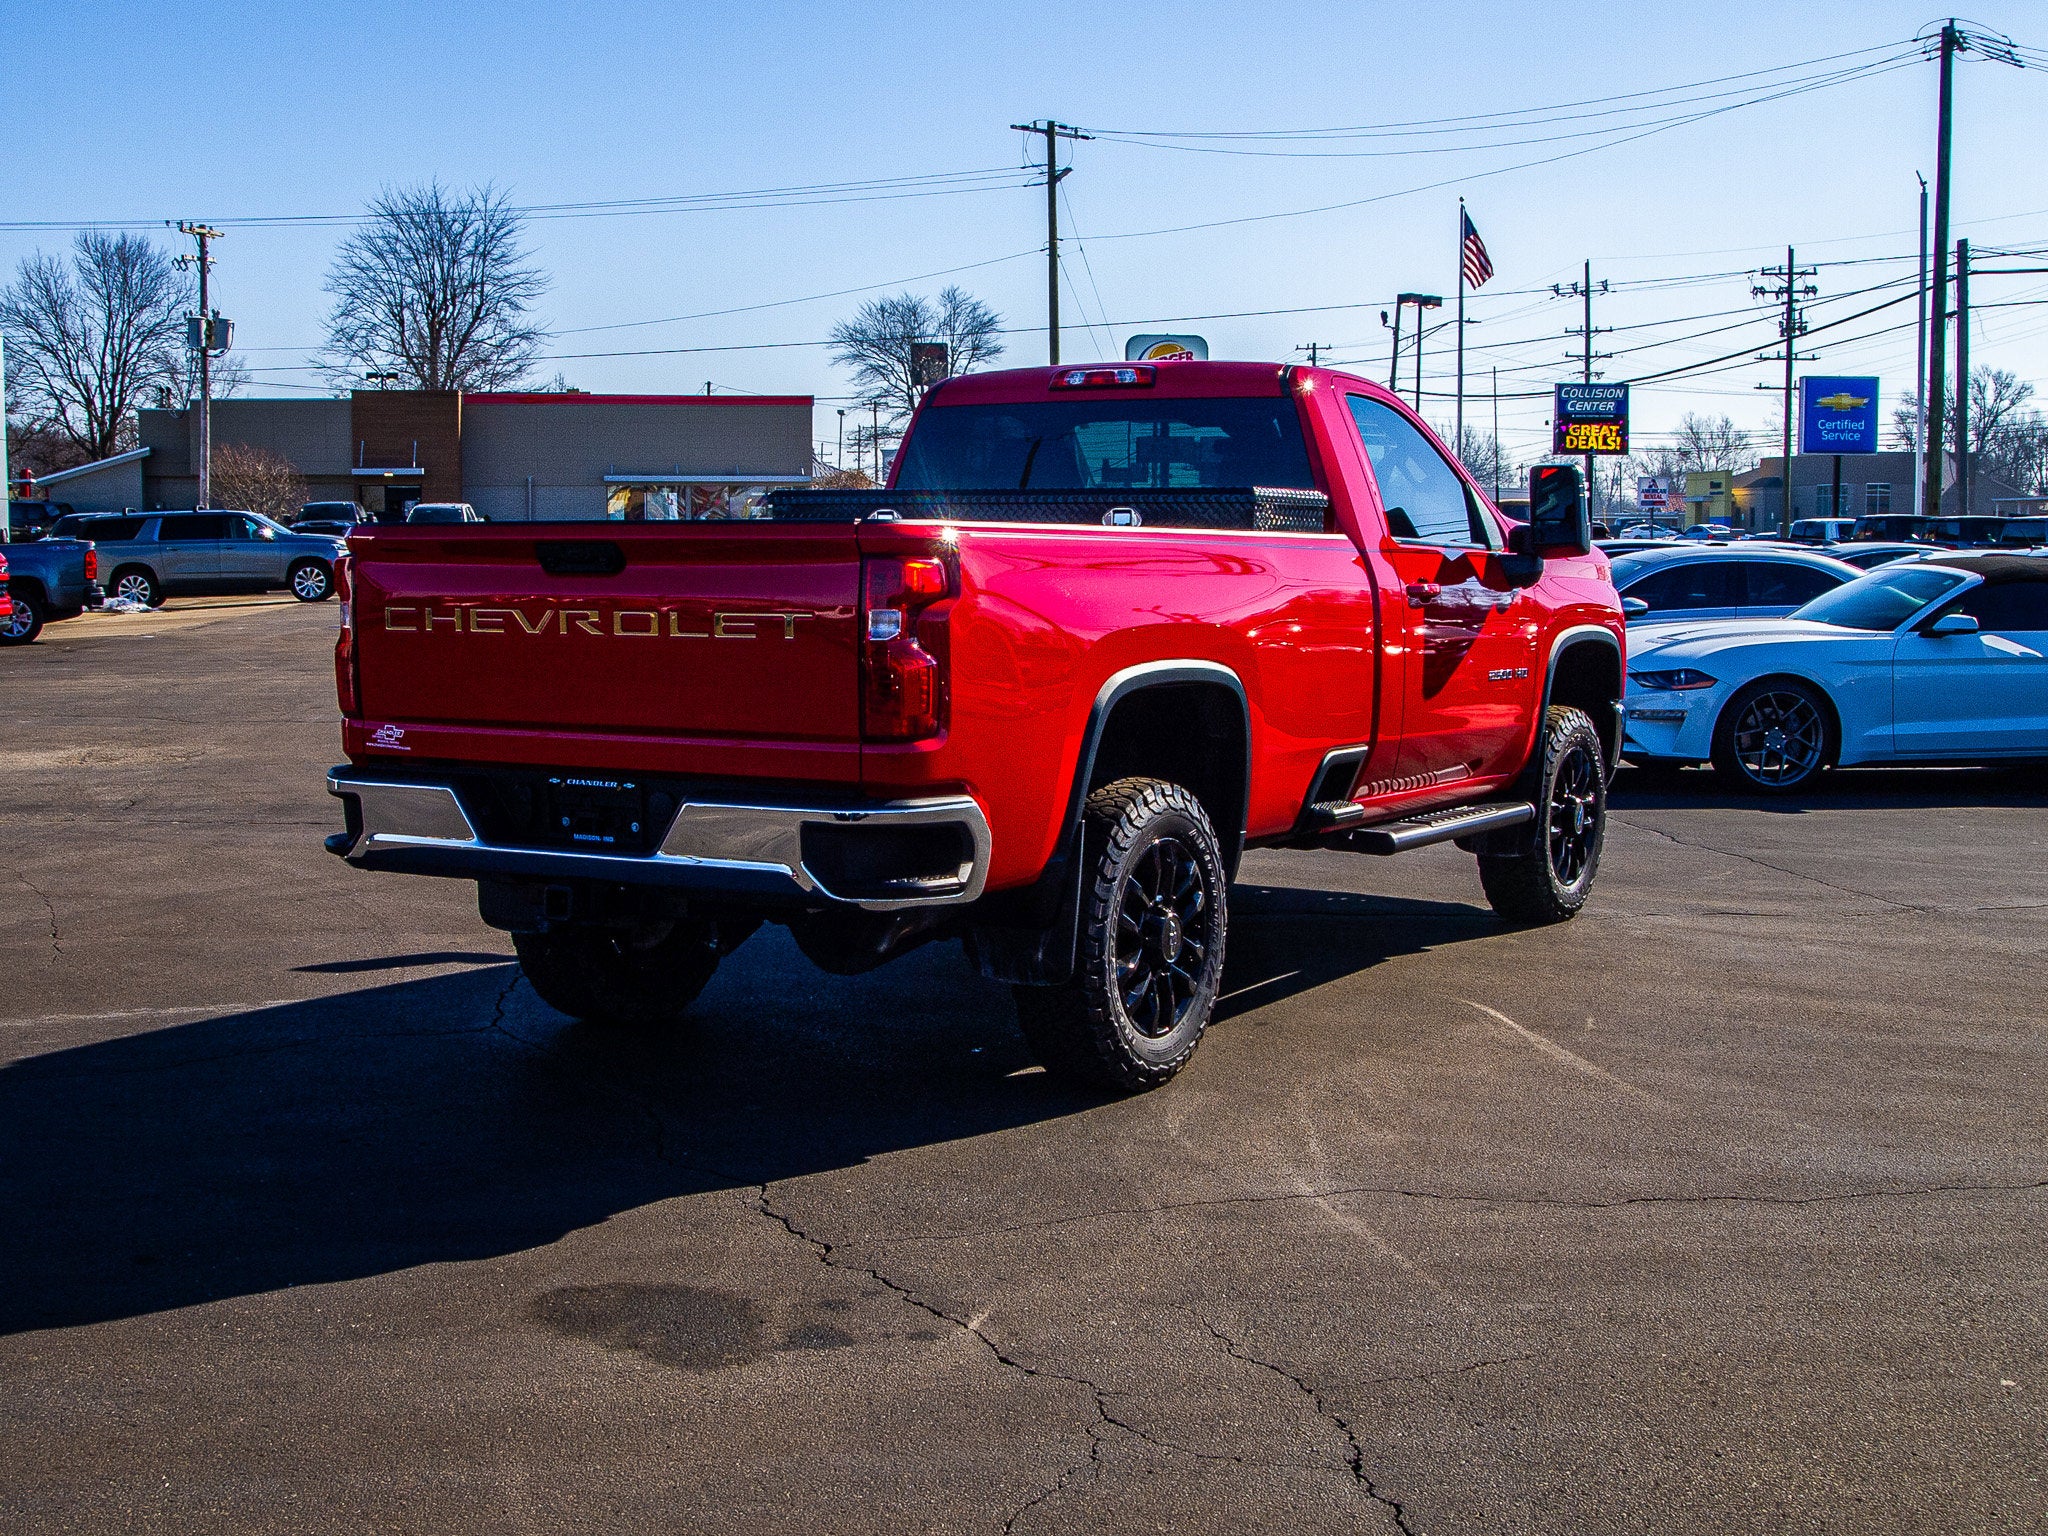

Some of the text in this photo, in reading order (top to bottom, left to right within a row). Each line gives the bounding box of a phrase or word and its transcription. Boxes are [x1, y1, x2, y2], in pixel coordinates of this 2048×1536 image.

[1561, 387, 1625, 399] COLLISION
[1567, 400, 1616, 411] CENTER
[1818, 419, 1865, 430] Certified
[1568, 424, 1620, 437] GREAT
[1821, 430, 1861, 441] Service
[1565, 435, 1622, 450] DEALS!
[384, 607, 814, 639] CHEVROLET
[566, 778, 618, 788] CHANDLER
